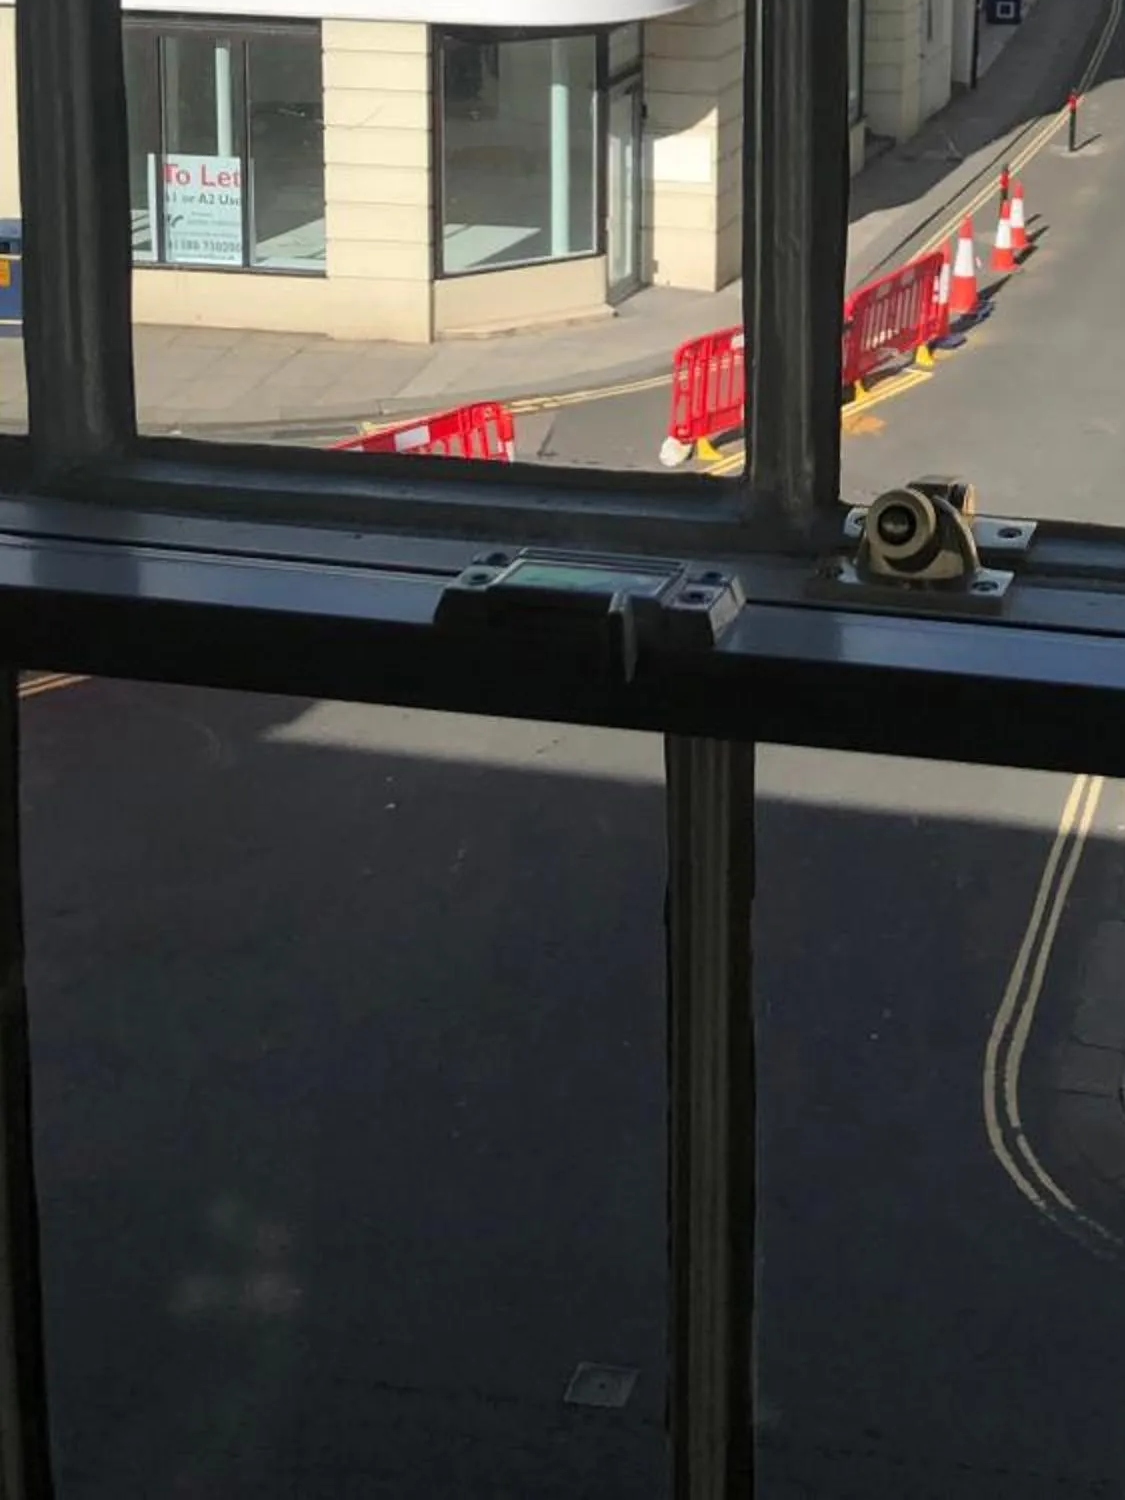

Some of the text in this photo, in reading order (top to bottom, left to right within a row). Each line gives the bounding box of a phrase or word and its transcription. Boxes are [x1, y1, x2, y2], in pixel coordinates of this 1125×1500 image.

[163, 163, 240, 188] To Let
[199, 193, 215, 205] A2
